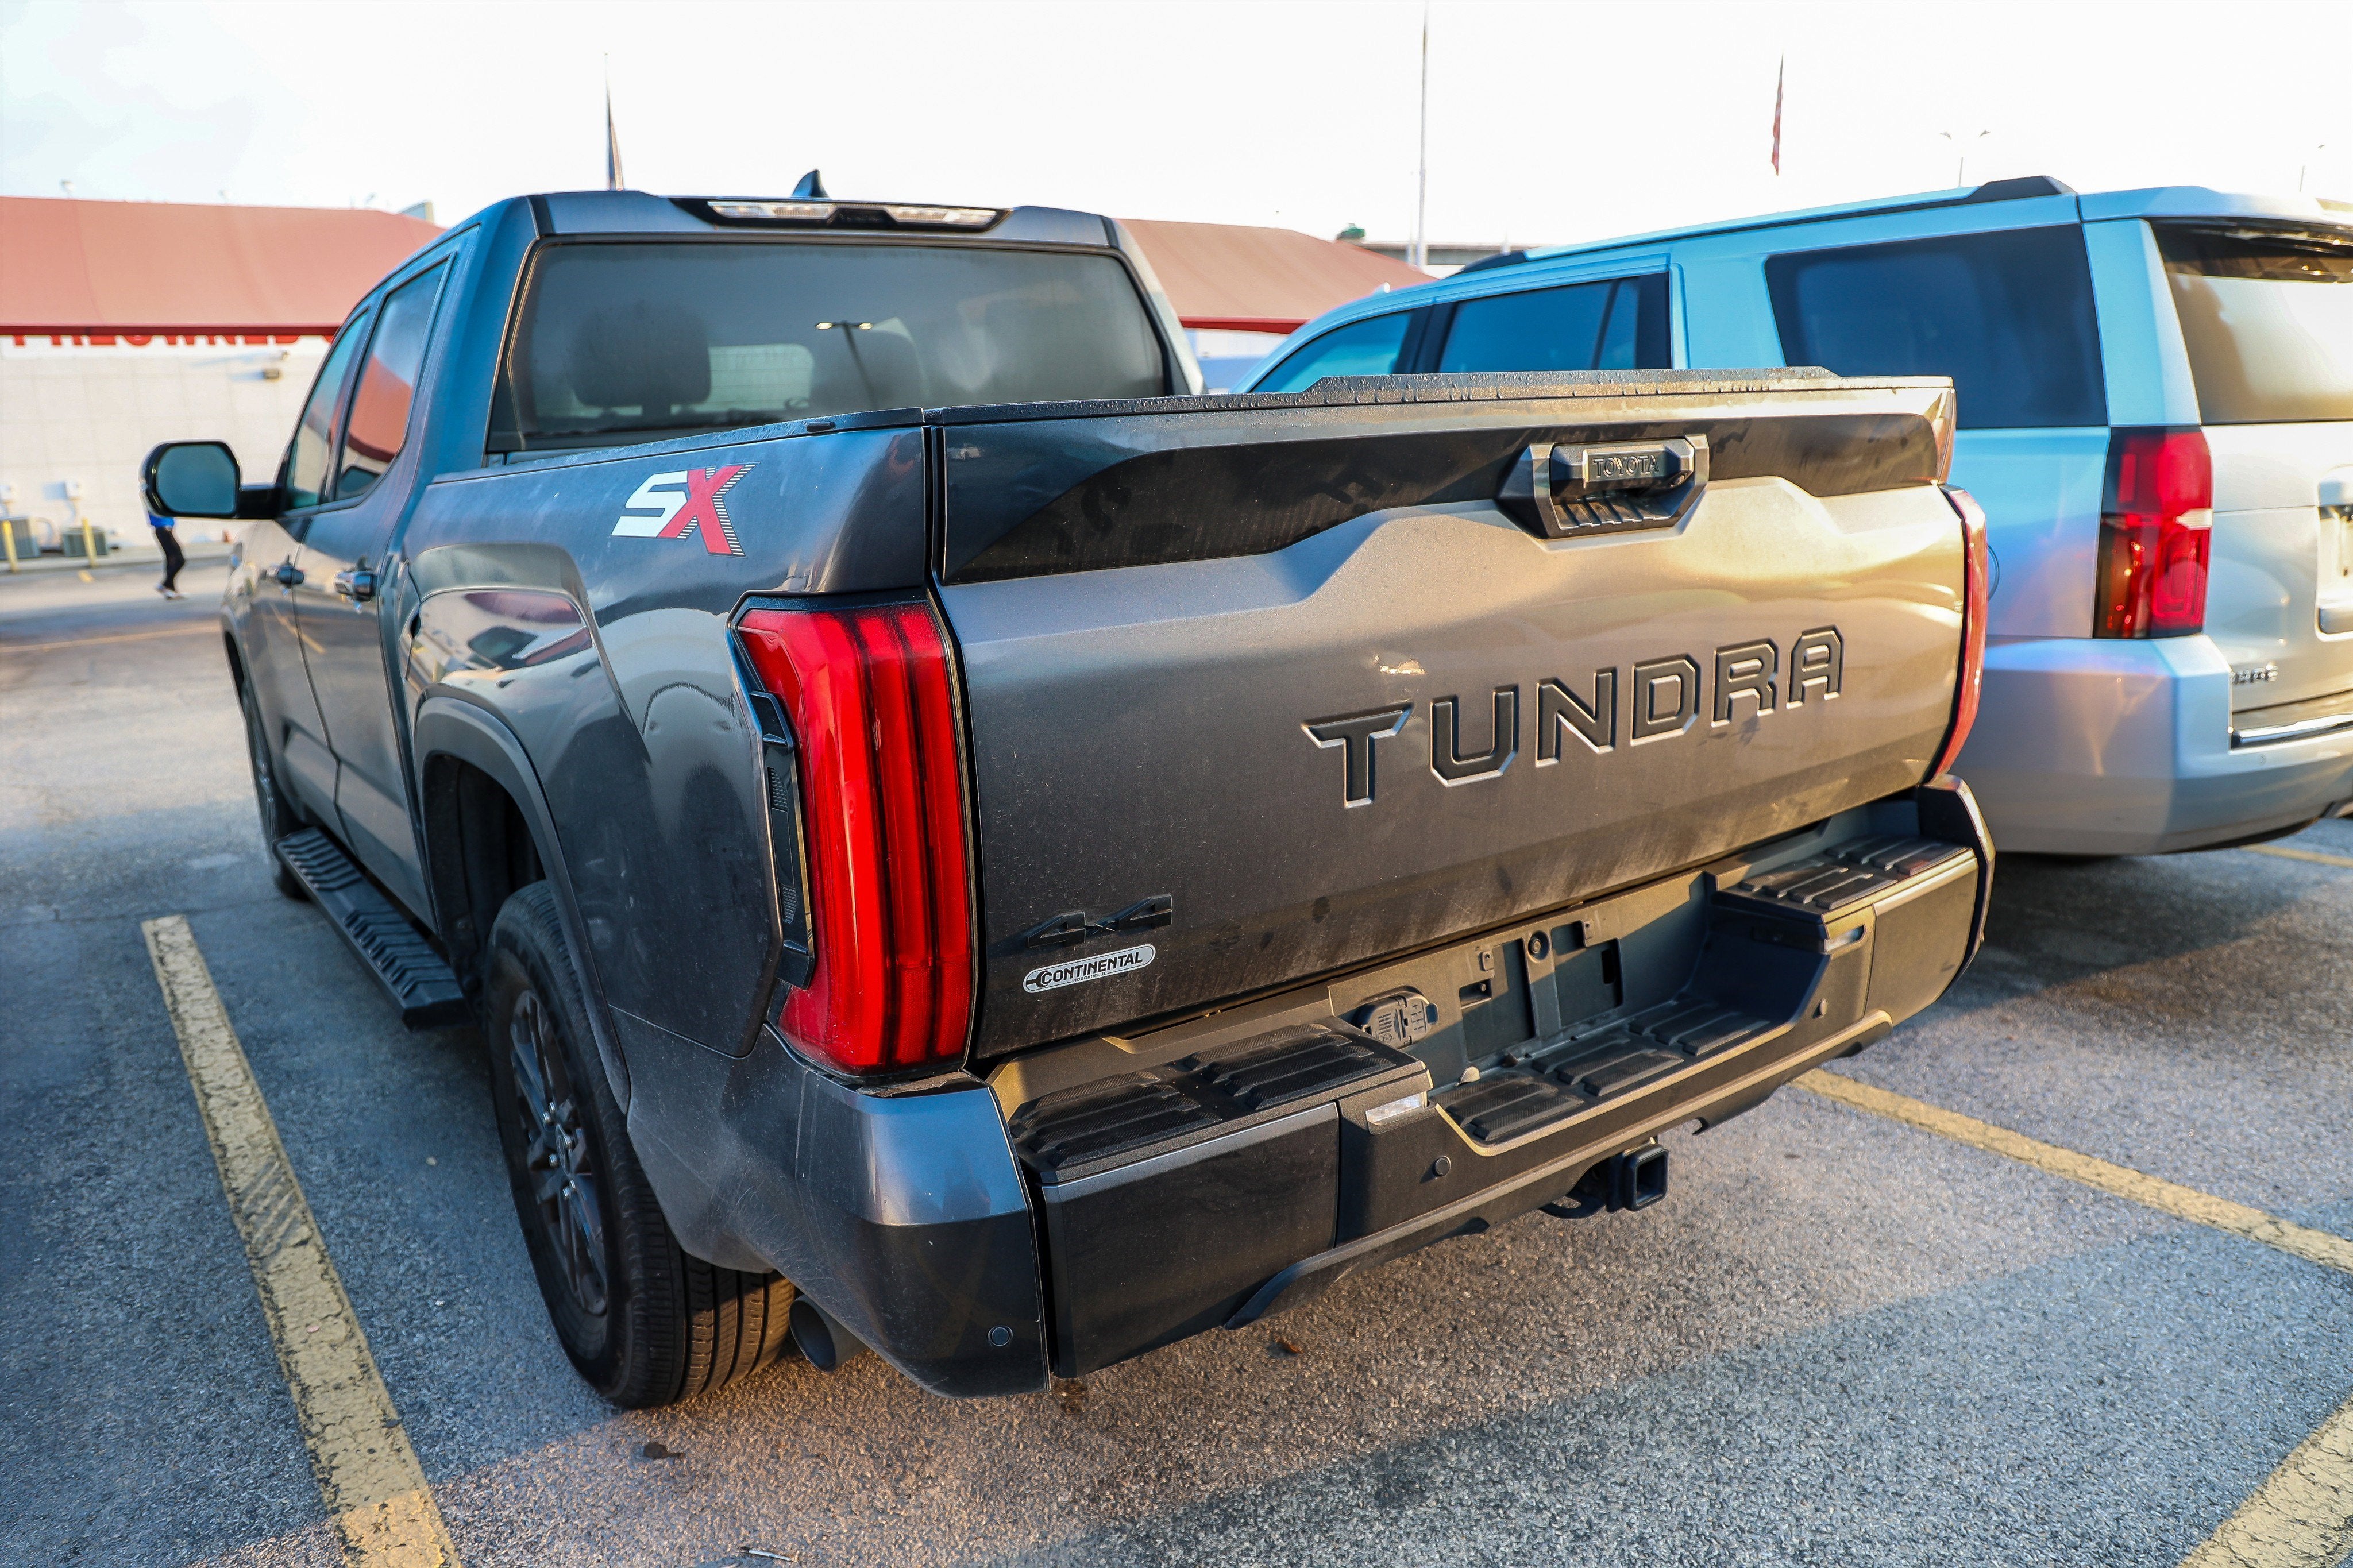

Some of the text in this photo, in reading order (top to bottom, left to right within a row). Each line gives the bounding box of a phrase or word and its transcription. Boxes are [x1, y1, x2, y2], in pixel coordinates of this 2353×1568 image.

[1592, 454, 1660, 478] TOYOTA
[1301, 624, 1846, 808] TUNDRA
[1040, 952, 1143, 987] CONTINENTAL
[1073, 974, 1101, 982] HODGKINS,
